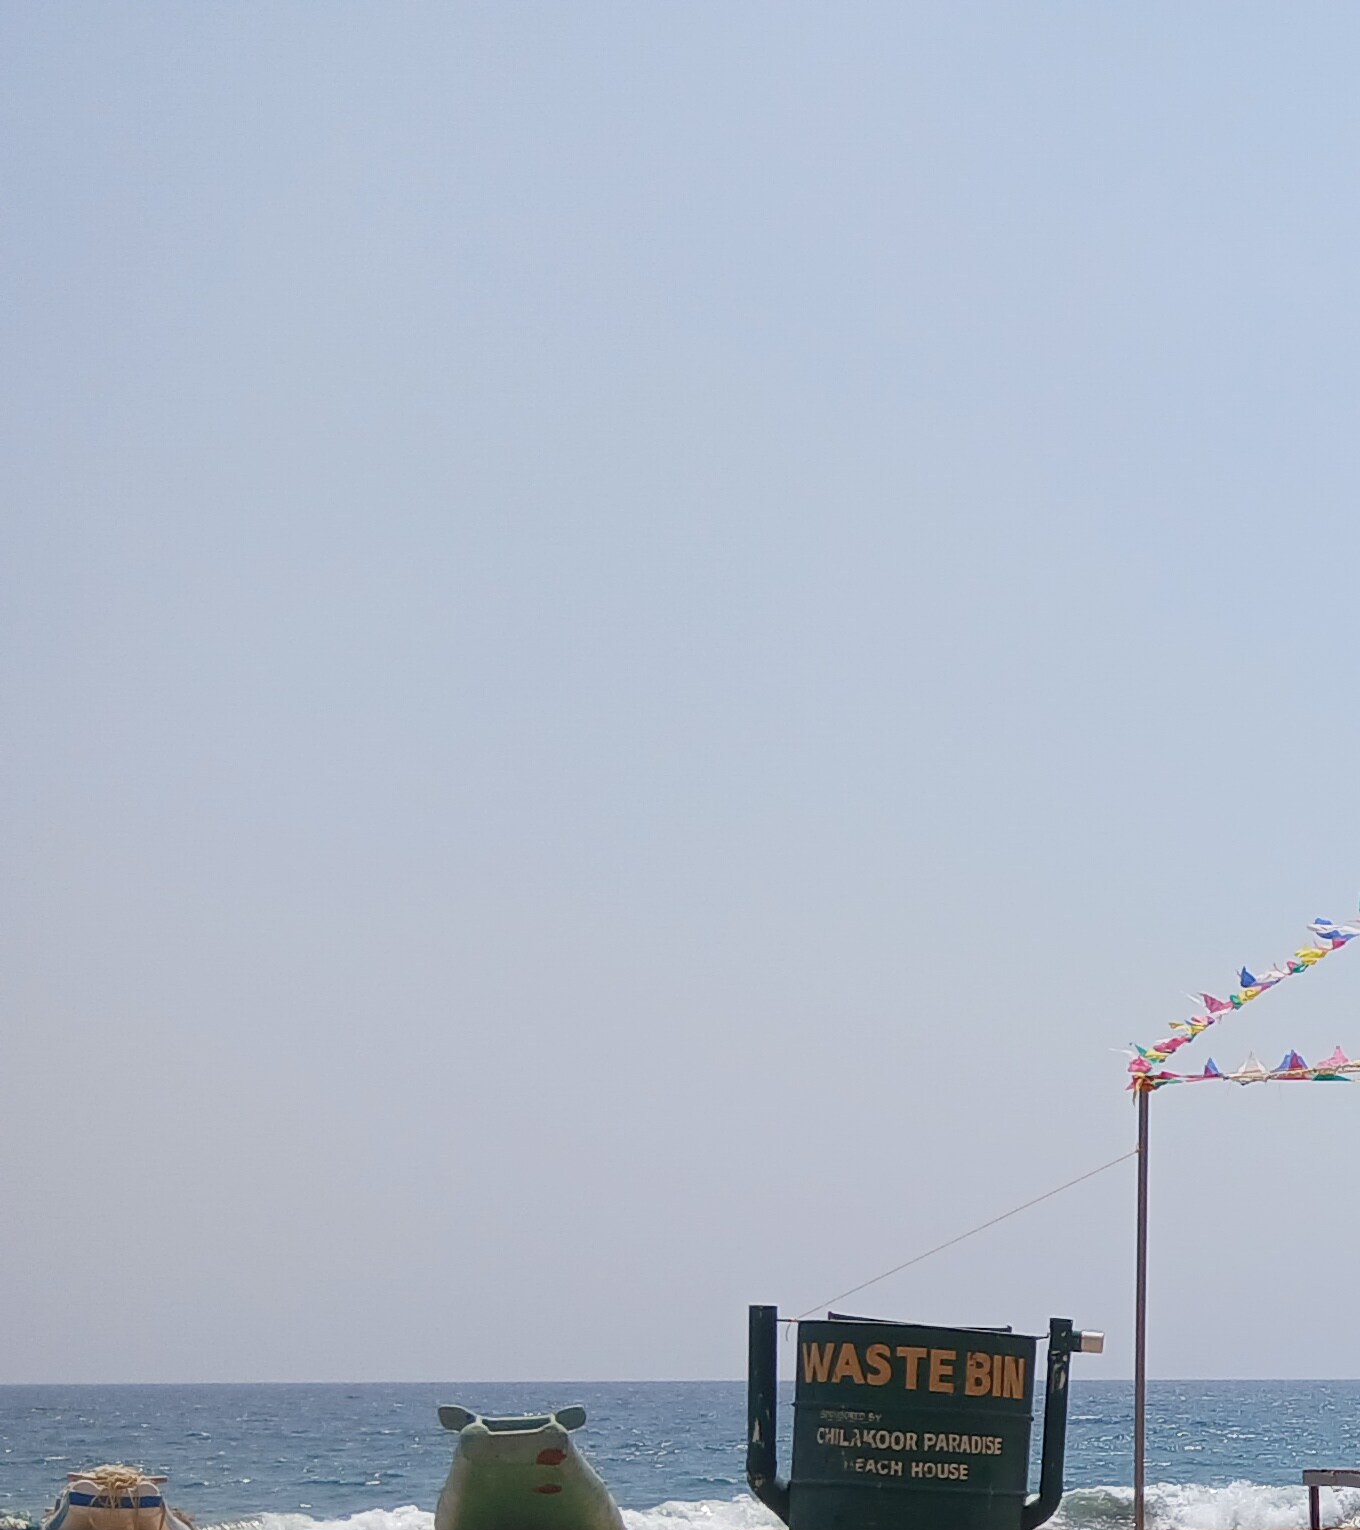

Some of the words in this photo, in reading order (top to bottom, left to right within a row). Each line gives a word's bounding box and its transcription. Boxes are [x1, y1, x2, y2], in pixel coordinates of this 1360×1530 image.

[802, 1342, 956, 1394] WASTE
[964, 1352, 1026, 1400] BIN
[923, 1433, 1003, 1455] PARADISE
[843, 1458, 903, 1476] EACH
[911, 1461, 969, 1480] HOUSE
